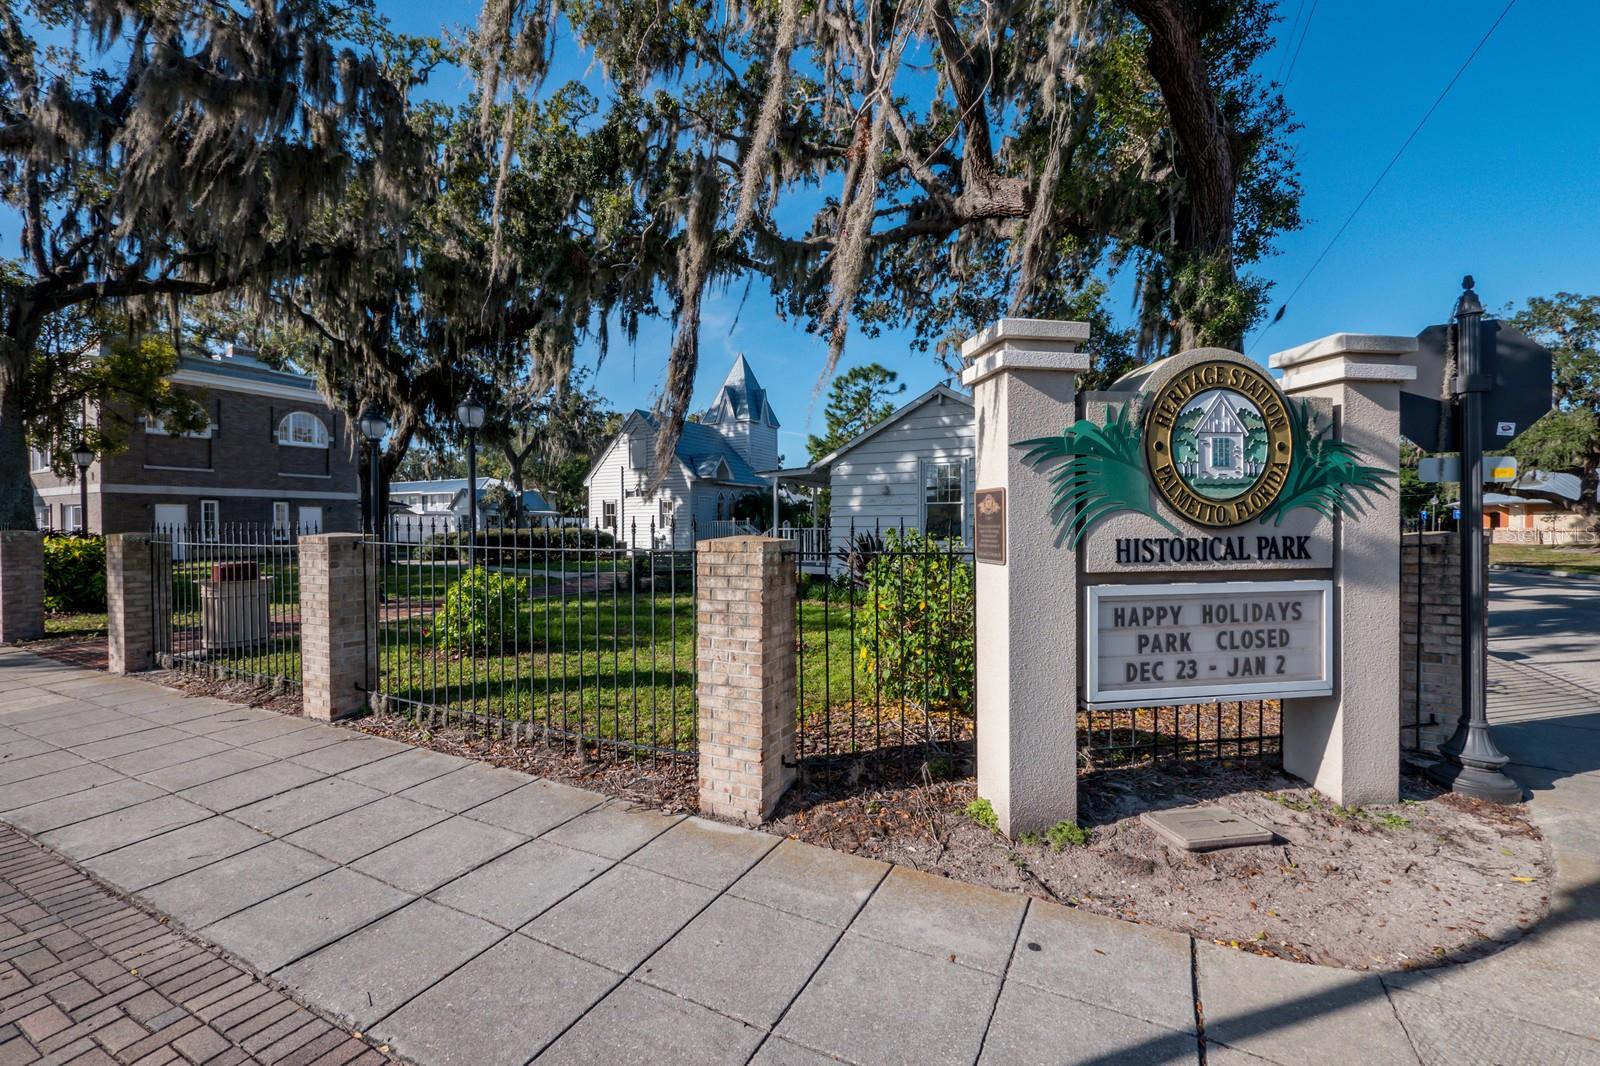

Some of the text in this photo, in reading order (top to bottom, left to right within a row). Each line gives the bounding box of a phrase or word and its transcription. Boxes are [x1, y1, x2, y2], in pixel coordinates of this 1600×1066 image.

[1153, 366, 1286, 430] HERITAGE STATION
[1155, 461, 1288, 526] PALMETTO, FLORIDA
[1115, 535, 1312, 564] HISTORICAL PARK
[1113, 601, 1303, 627] HAPPY HOLIDAYS
[1137, 628, 1290, 654] PARK CLOSED
[1126, 660, 1164, 682] DEC
[1176, 659, 1198, 680] 23
[1227, 655, 1266, 677] JAN
[1275, 655, 1286, 674] 2
